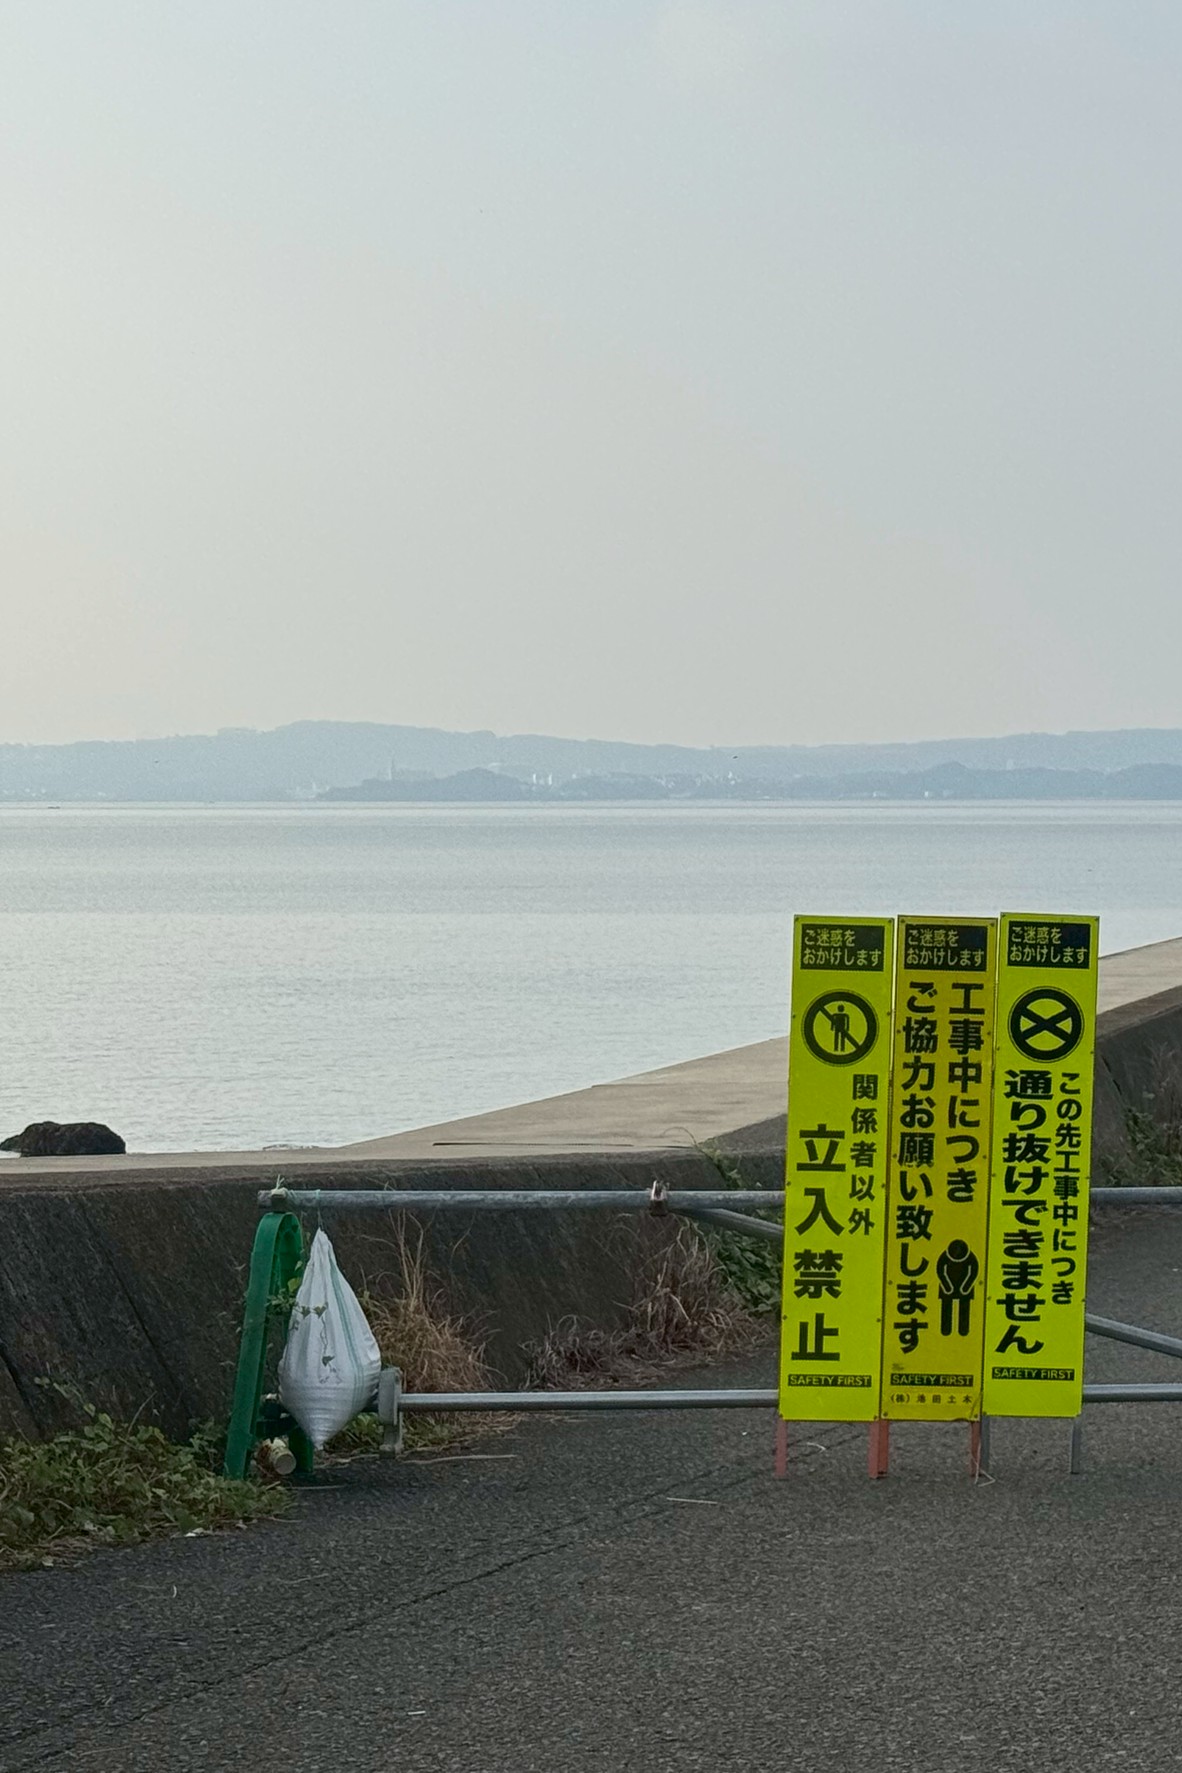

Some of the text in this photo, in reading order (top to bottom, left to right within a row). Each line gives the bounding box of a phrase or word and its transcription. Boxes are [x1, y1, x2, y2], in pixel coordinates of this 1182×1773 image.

[804, 928, 855, 947] ご迷惑を
[907, 928, 959, 948] ご迷惑を
[1011, 926, 1062, 945] ご迷惑を
[803, 948, 881, 966] おかけします
[906, 948, 984, 967] おかけします
[1009, 944, 1087, 963] おかけします
[946, 983, 985, 1202] 工事中につき
[849, 1074, 879, 1236] 関係者以外
[893, 982, 939, 1355] ご協力お願い致します
[1051, 1072, 1082, 1305] この先工事中につき
[995, 1069, 1054, 1355] 通り抜けできません
[791, 1124, 846, 1361] 立入禁止
[790, 1375, 870, 1386] SAFETY FIRST
[892, 1375, 972, 1386] SAFETY FIRST
[994, 1368, 1073, 1379] SAFETY FIRST
